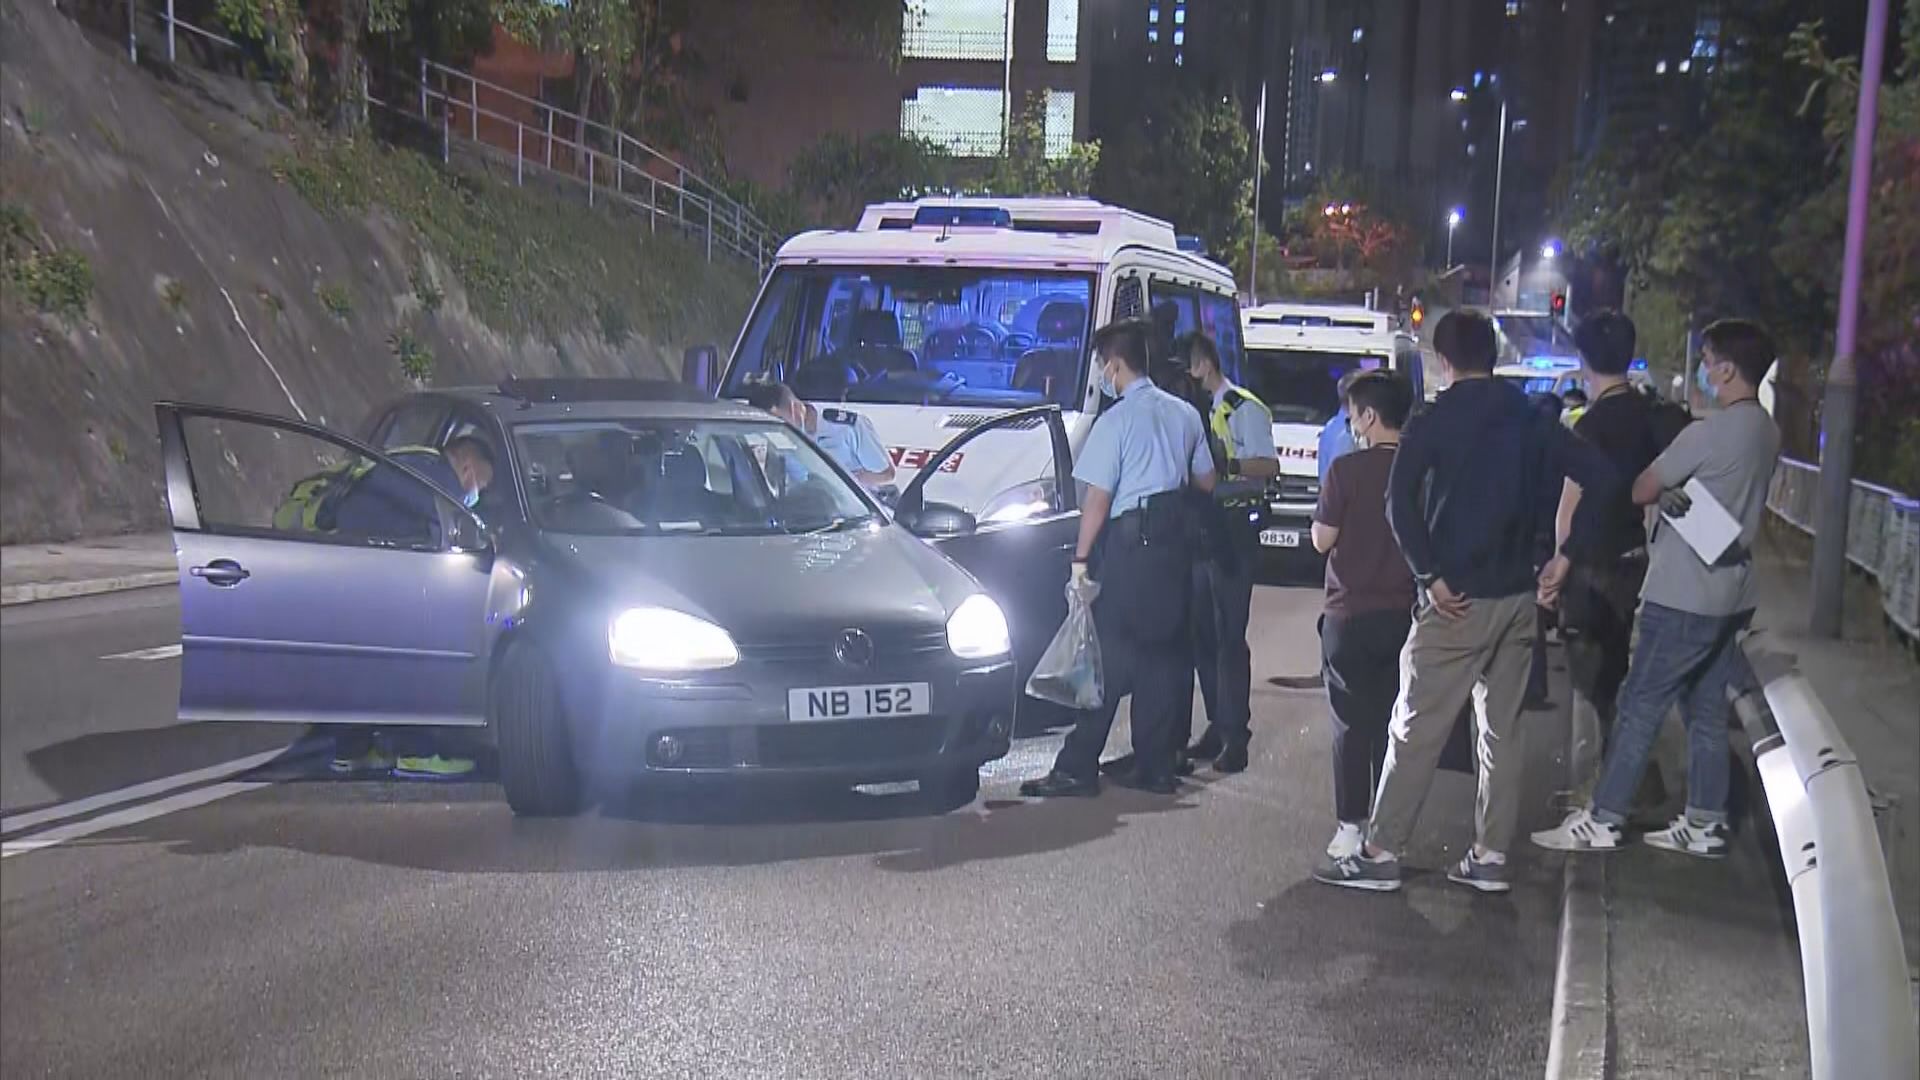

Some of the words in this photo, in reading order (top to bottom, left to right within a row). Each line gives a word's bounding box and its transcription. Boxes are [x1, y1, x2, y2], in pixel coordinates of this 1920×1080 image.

[1261, 532, 1295, 545] 9836
[808, 691, 850, 717] NB
[864, 688, 912, 715] 152
